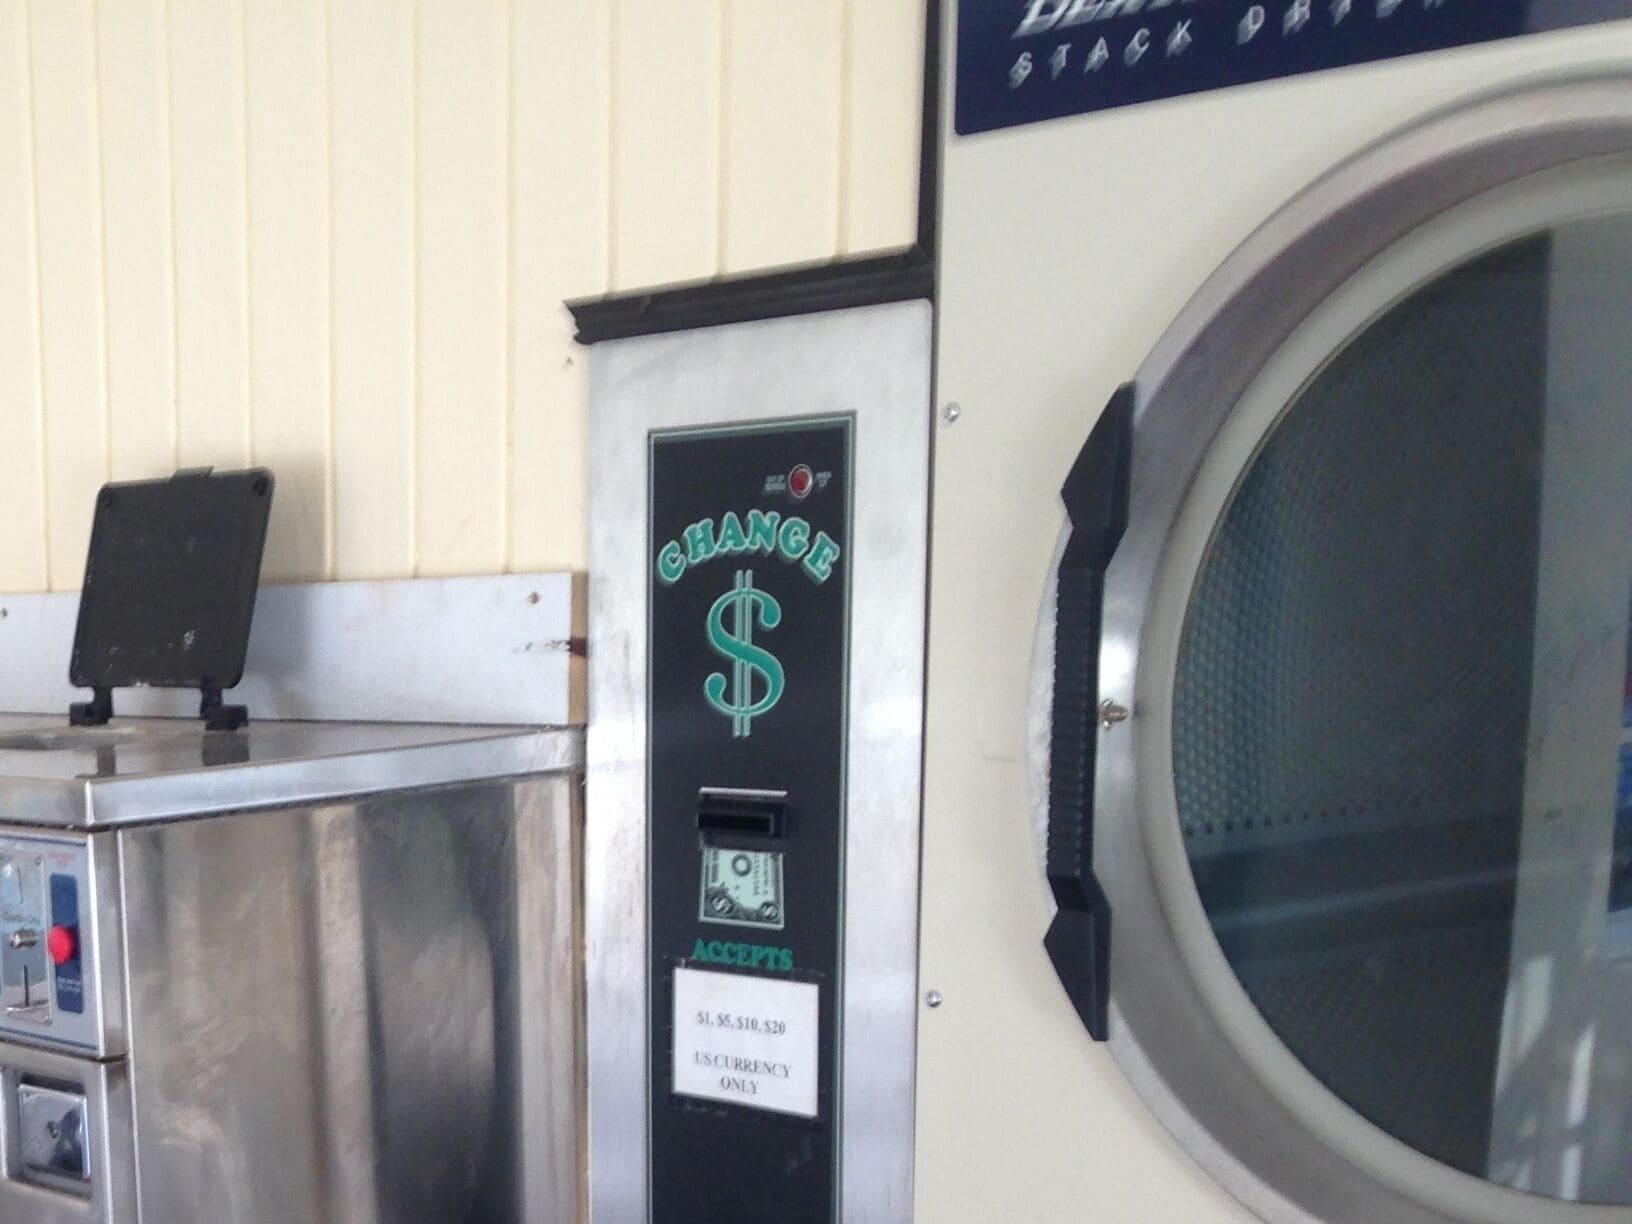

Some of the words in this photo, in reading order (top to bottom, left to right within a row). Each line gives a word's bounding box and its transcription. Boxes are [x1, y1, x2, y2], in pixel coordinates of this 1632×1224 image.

[1008, 18, 1193, 89] STACK
[657, 509, 841, 584] CHANGE
[690, 938, 794, 973] ACCEPTS
[697, 1010, 714, 1026] $1,
[764, 1019, 786, 1035] $20
[695, 1051, 712, 1067] US
[714, 1055, 793, 1079] CURRENCY
[720, 1076, 759, 1095] ONLY
